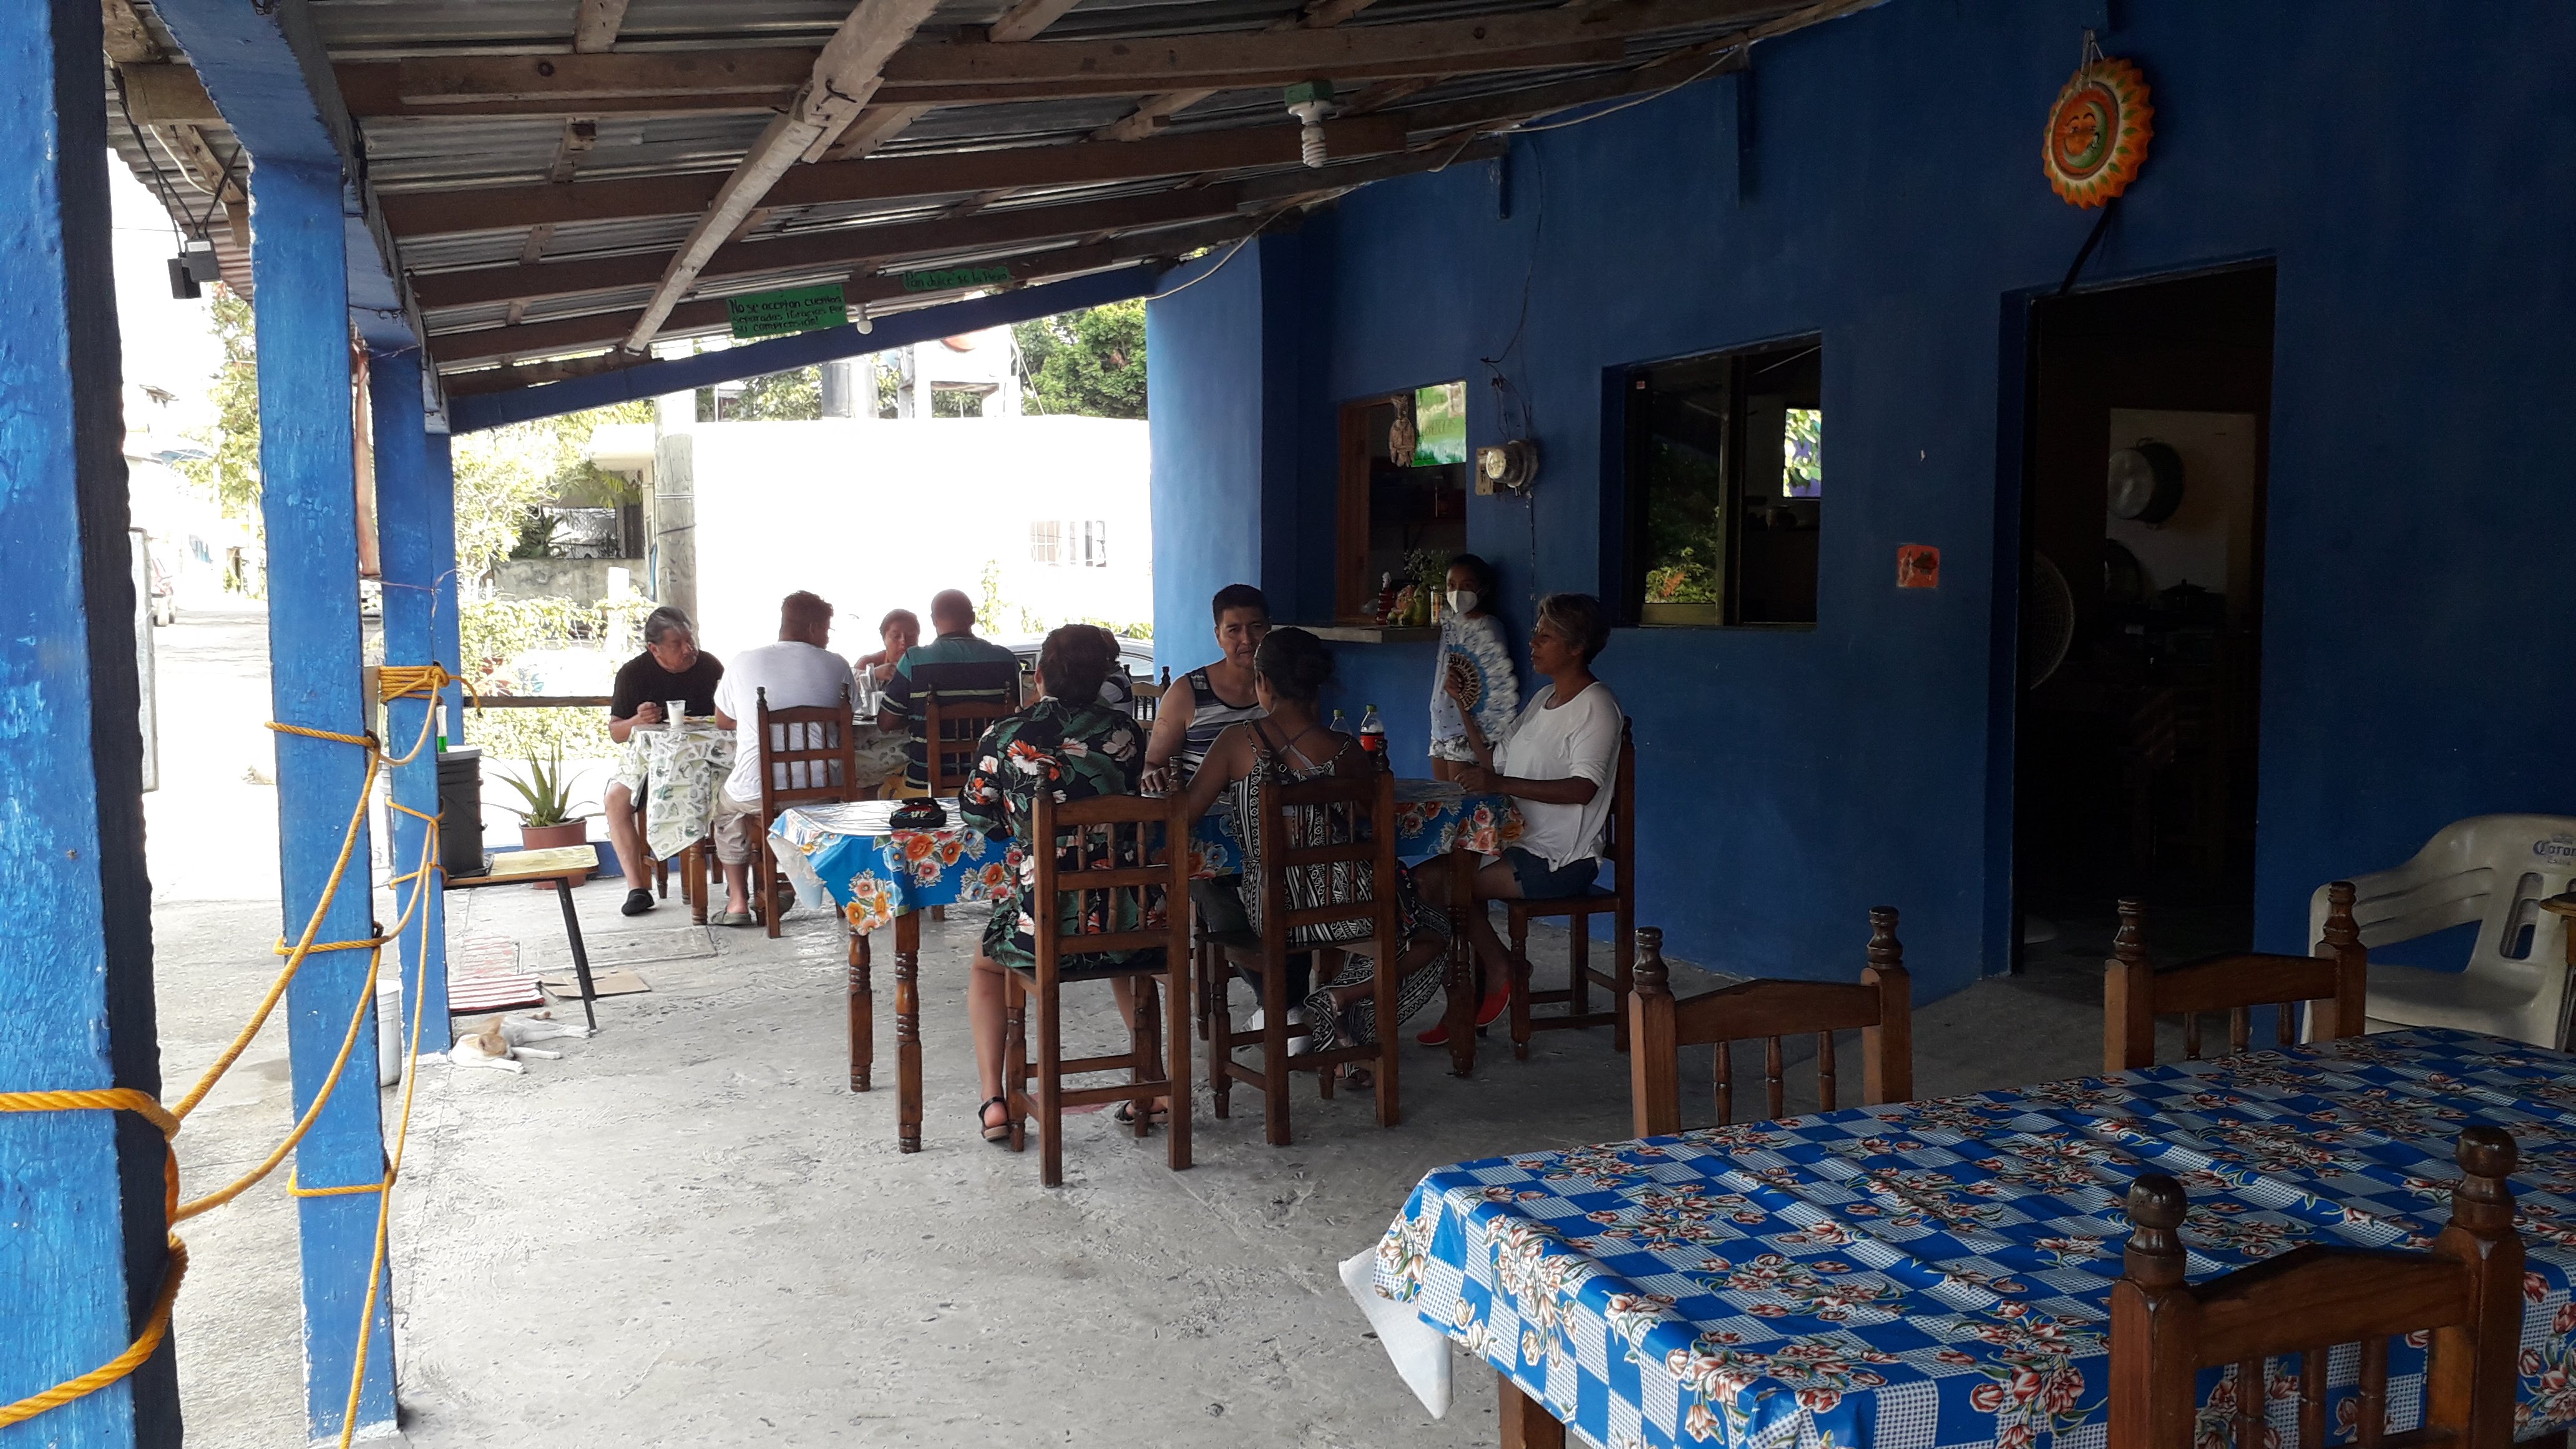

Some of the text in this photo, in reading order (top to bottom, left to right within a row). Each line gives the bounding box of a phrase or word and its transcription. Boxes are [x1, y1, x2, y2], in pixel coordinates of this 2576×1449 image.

[729, 299, 744, 314] No
[747, 303, 758, 313] se
[2532, 840, 2576, 856] Coron
